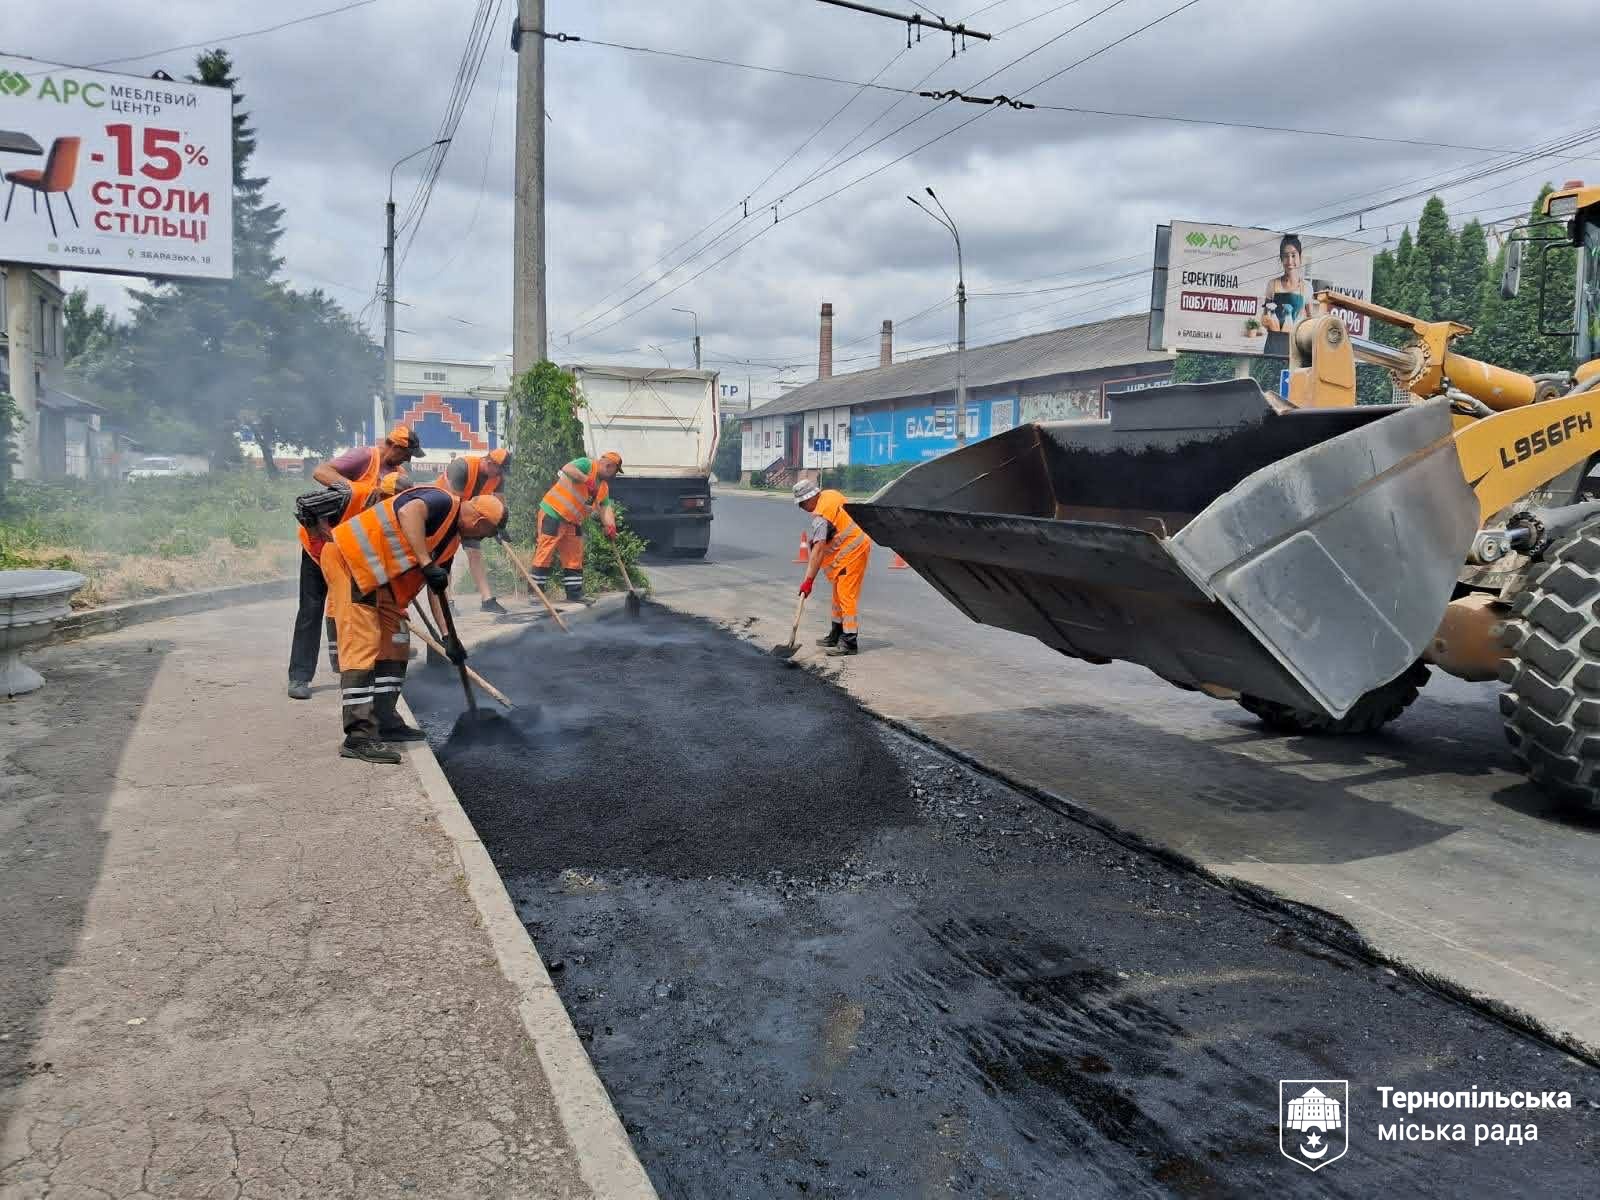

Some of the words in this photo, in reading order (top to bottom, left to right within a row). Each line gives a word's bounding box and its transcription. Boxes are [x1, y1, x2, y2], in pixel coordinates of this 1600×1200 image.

[37, 77, 105, 108] АРС
[110, 85, 197, 107] МЕБЛЕВИЙ
[111, 101, 161, 116] ЦЕНТР
[91, 181, 210, 215] СТОЛИ
[94, 210, 207, 243] СТІЛЬЦІ
[63, 245, 101, 256] ARS.UA
[1209, 233, 1241, 251] АРС
[1182, 271, 1239, 289] ЕФЕКТИВНА
[1182, 295, 1229, 312] ПОБУТОВА
[1230, 299, 1256, 314] ХІМІЯ
[1499, 411, 1593, 470] L956FH
